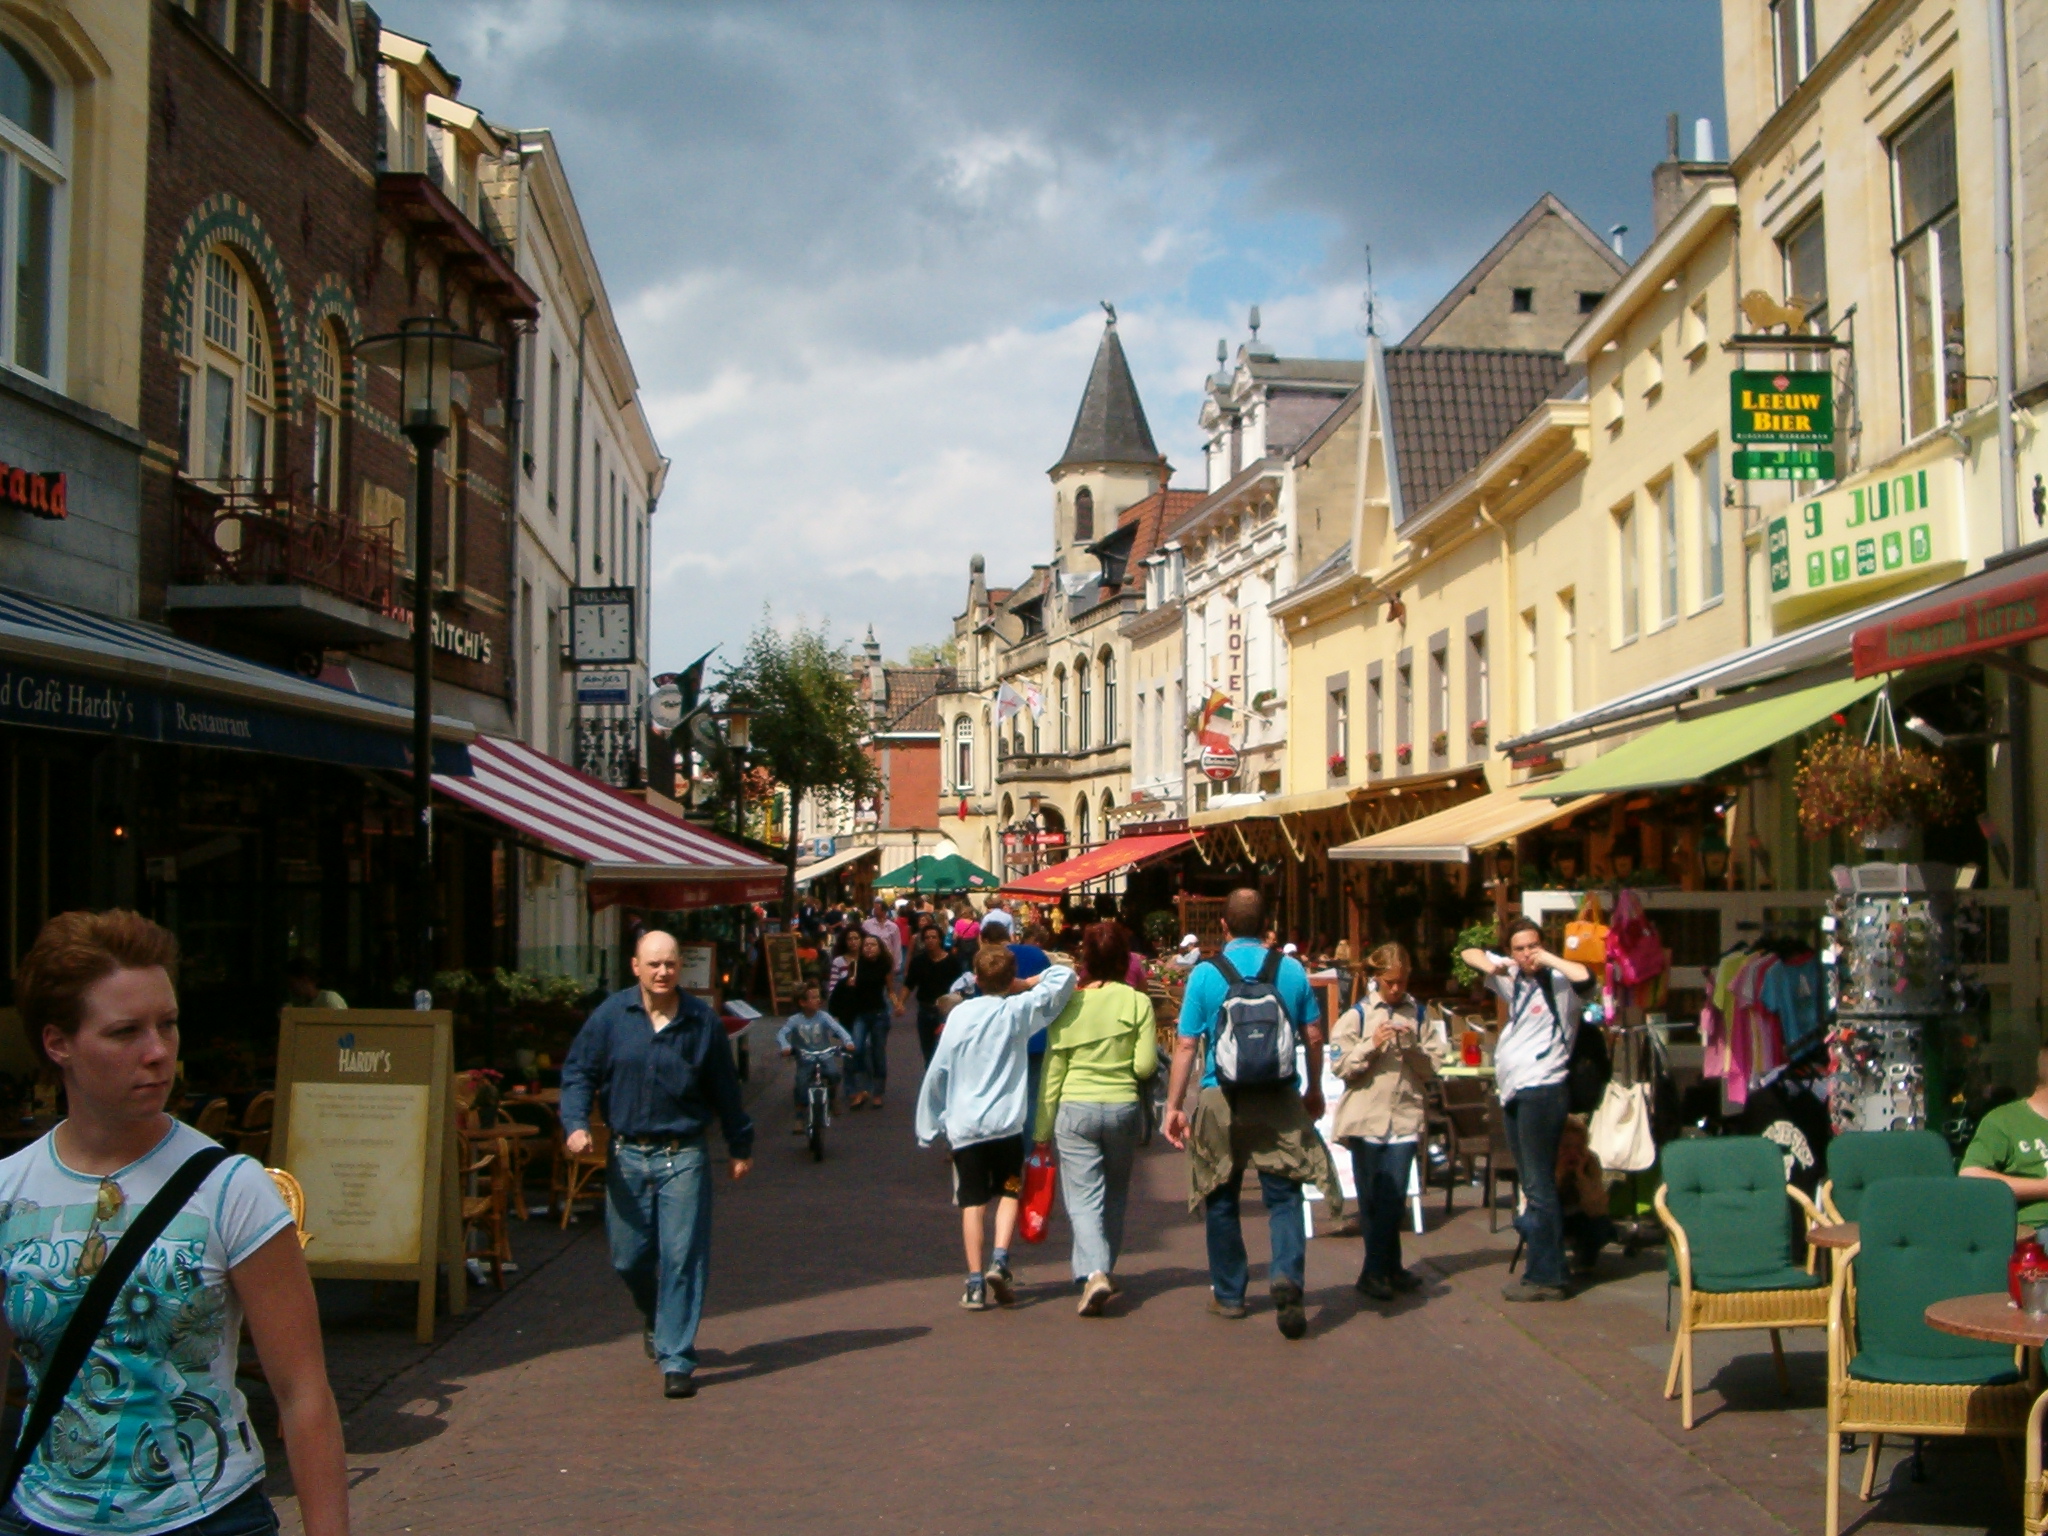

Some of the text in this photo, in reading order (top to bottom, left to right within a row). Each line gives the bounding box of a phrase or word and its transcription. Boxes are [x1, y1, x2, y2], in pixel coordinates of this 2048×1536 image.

[1741, 390, 1821, 410] LEEUW
[1753, 411, 1812, 431] BIER
[1229, 613, 1242, 705] HOTE
[17, 676, 61, 713] Café
[67, 684, 134, 729] Hardy's
[176, 702, 251, 738] Restaurant
[338, 1047, 392, 1073] HARDY'S
